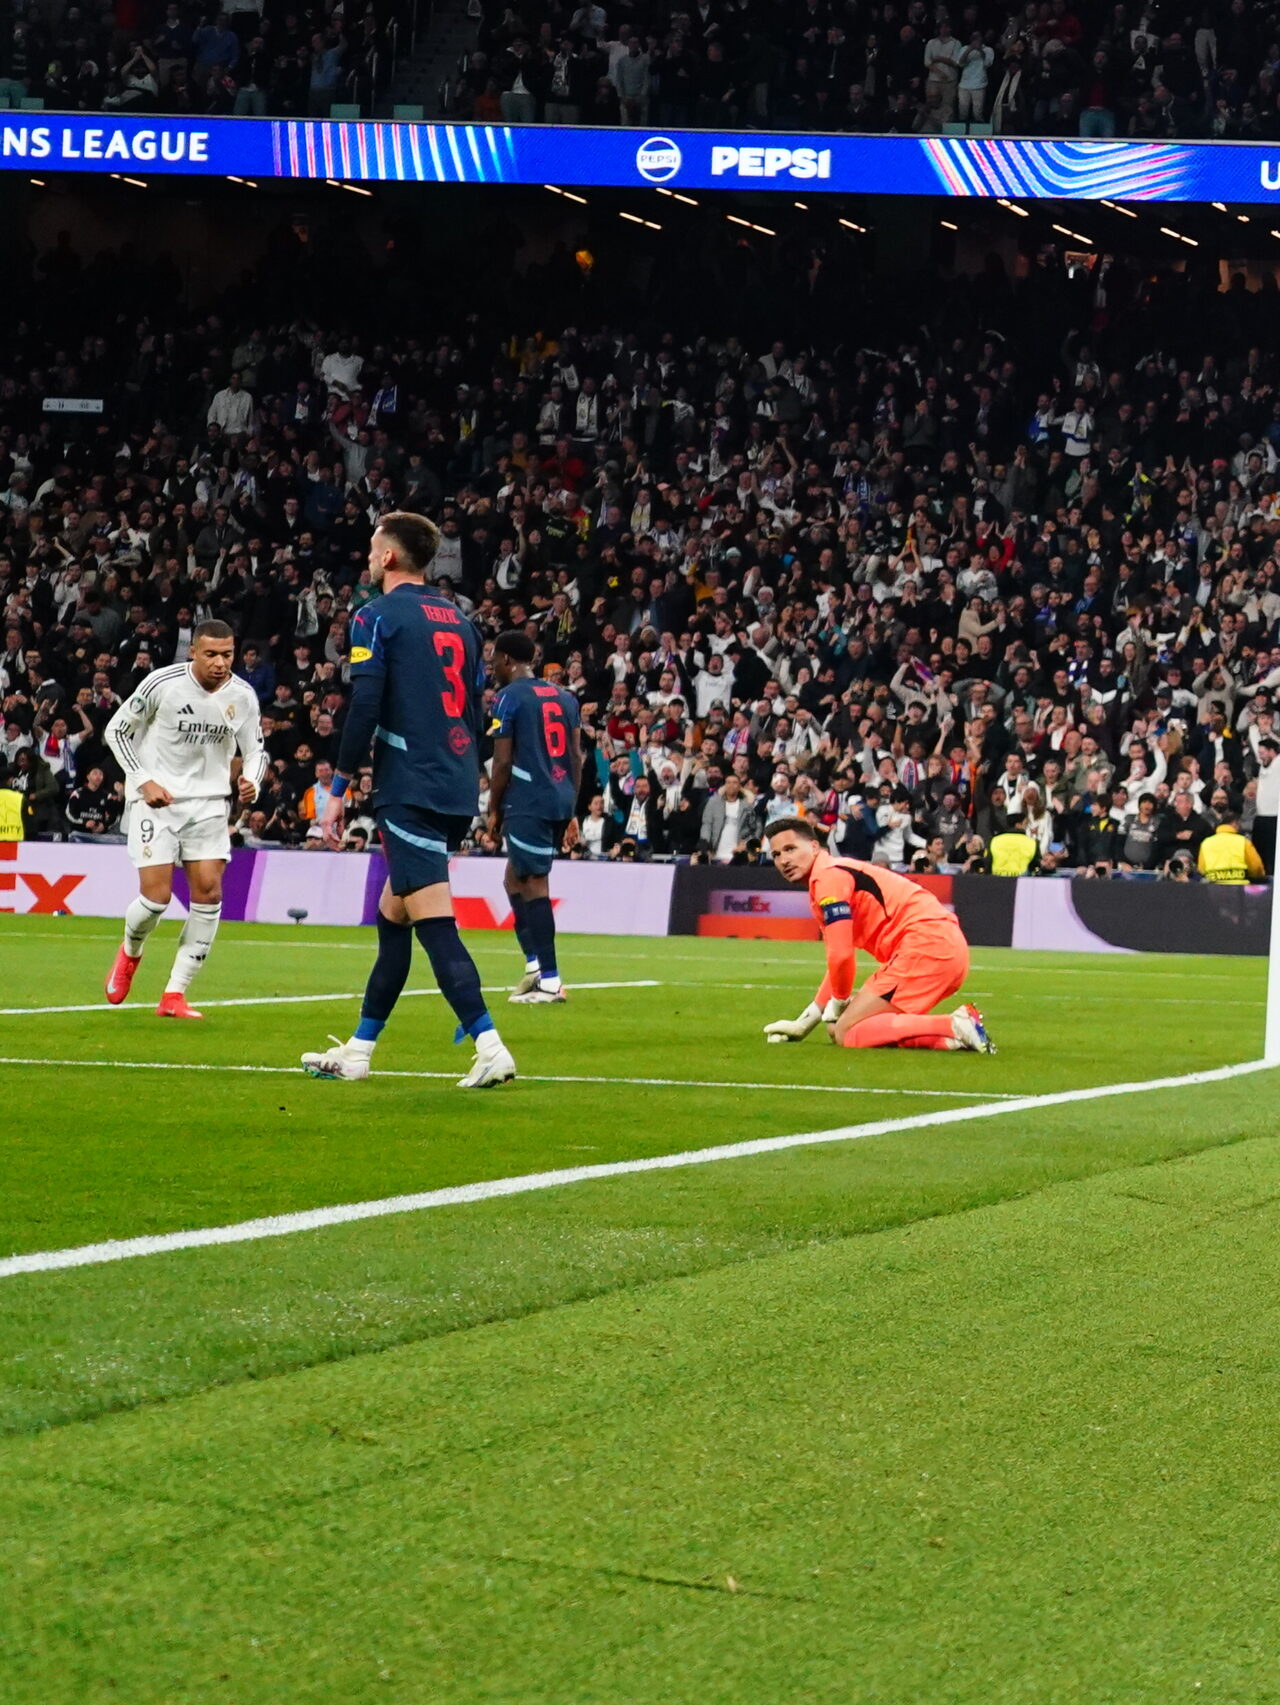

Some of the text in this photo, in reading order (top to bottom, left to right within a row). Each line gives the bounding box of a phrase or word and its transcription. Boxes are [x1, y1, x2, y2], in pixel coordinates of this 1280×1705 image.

[61, 128, 209, 162] LEAGUE
[640, 155, 677, 163] PEPSI
[711, 146, 831, 179] PEPSI
[433, 631, 466, 718] 3
[178, 720, 234, 736] Emirates
[542, 701, 566, 757] 6
[140, 818, 155, 843] 9
[723, 895, 772, 913] FedEx
